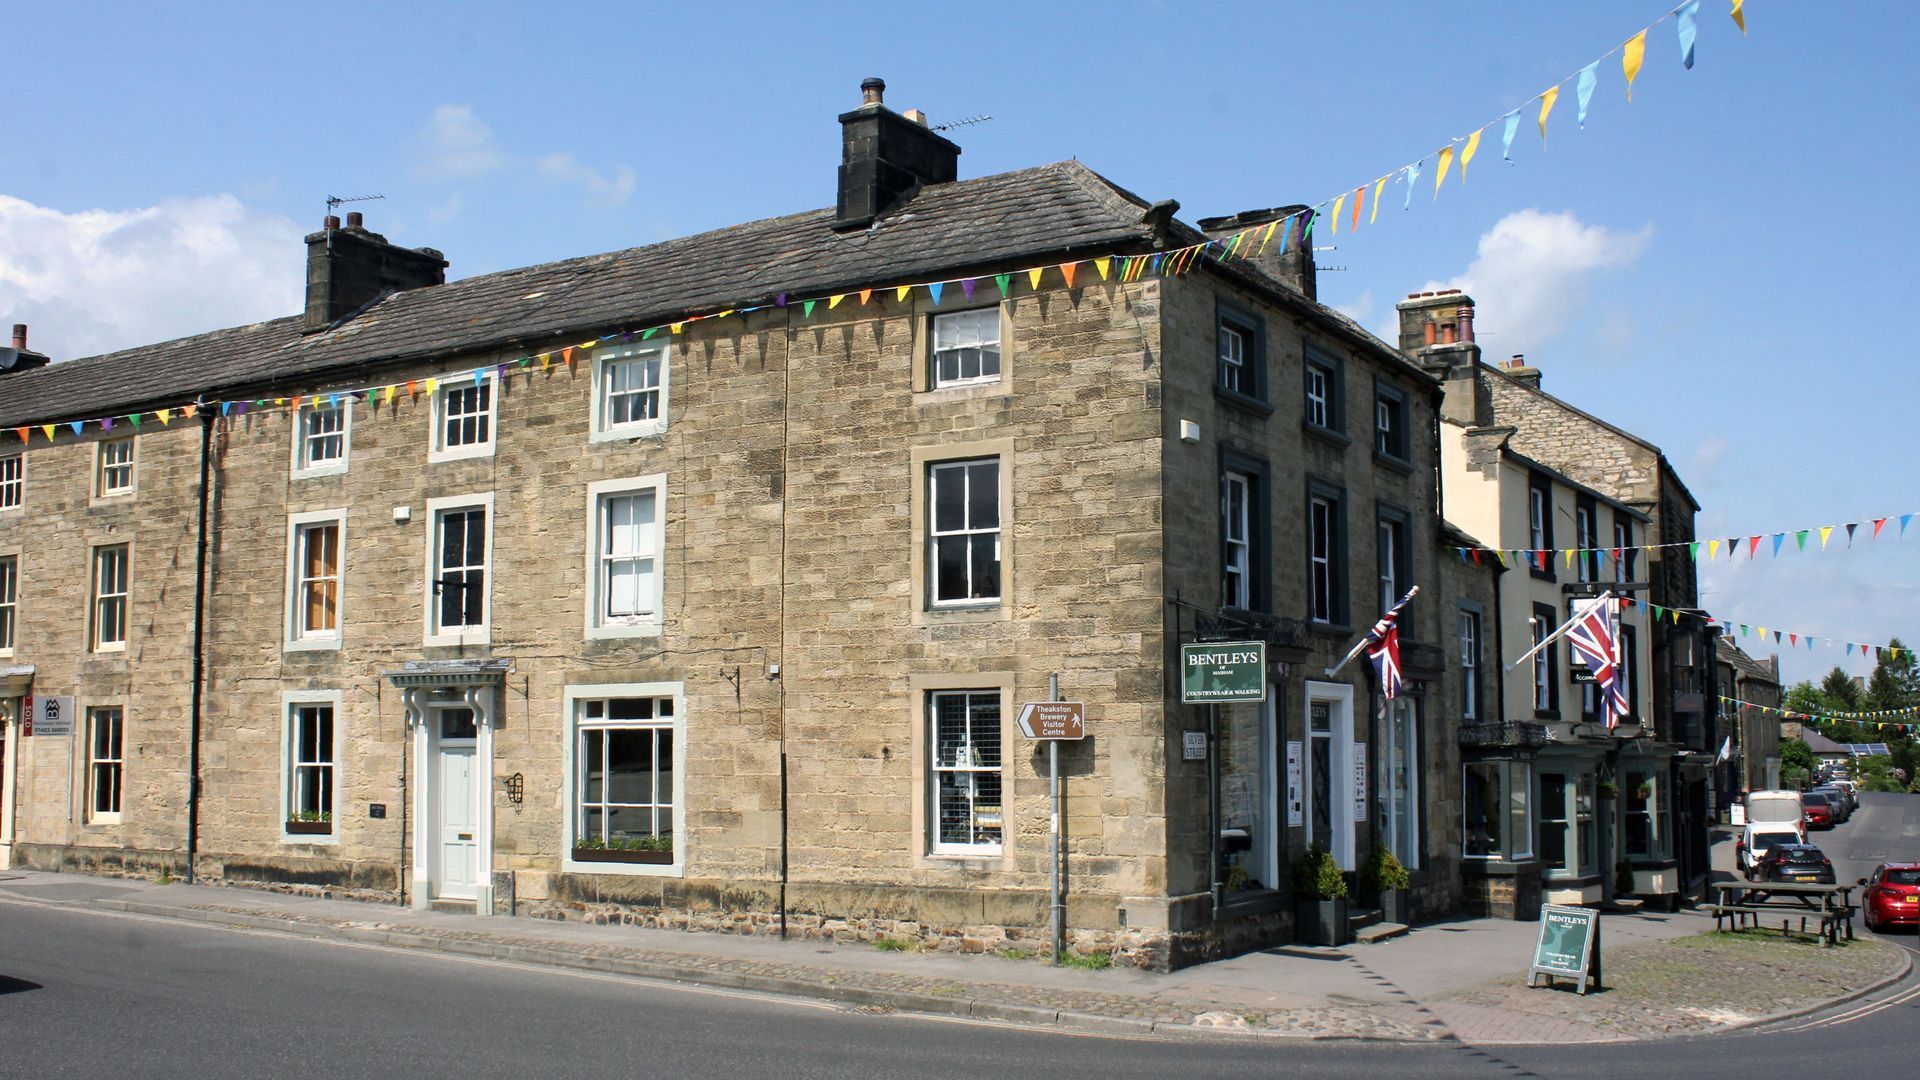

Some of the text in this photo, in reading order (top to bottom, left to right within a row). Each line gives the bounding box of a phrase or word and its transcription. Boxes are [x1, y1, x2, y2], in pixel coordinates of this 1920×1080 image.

[1188, 652, 1258, 666] BENTLEYS
[1234, 688, 1261, 696] WALKING
[1037, 705, 1072, 713] Theakston
[24, 705, 32, 728] SOLD
[1040, 713, 1067, 721] Brewery
[1042, 728, 1066, 736] Centre
[1187, 735, 1205, 745] SILVER
[1186, 747, 1206, 758] STREET
[1548, 914, 1588, 925] BENTLEYS
